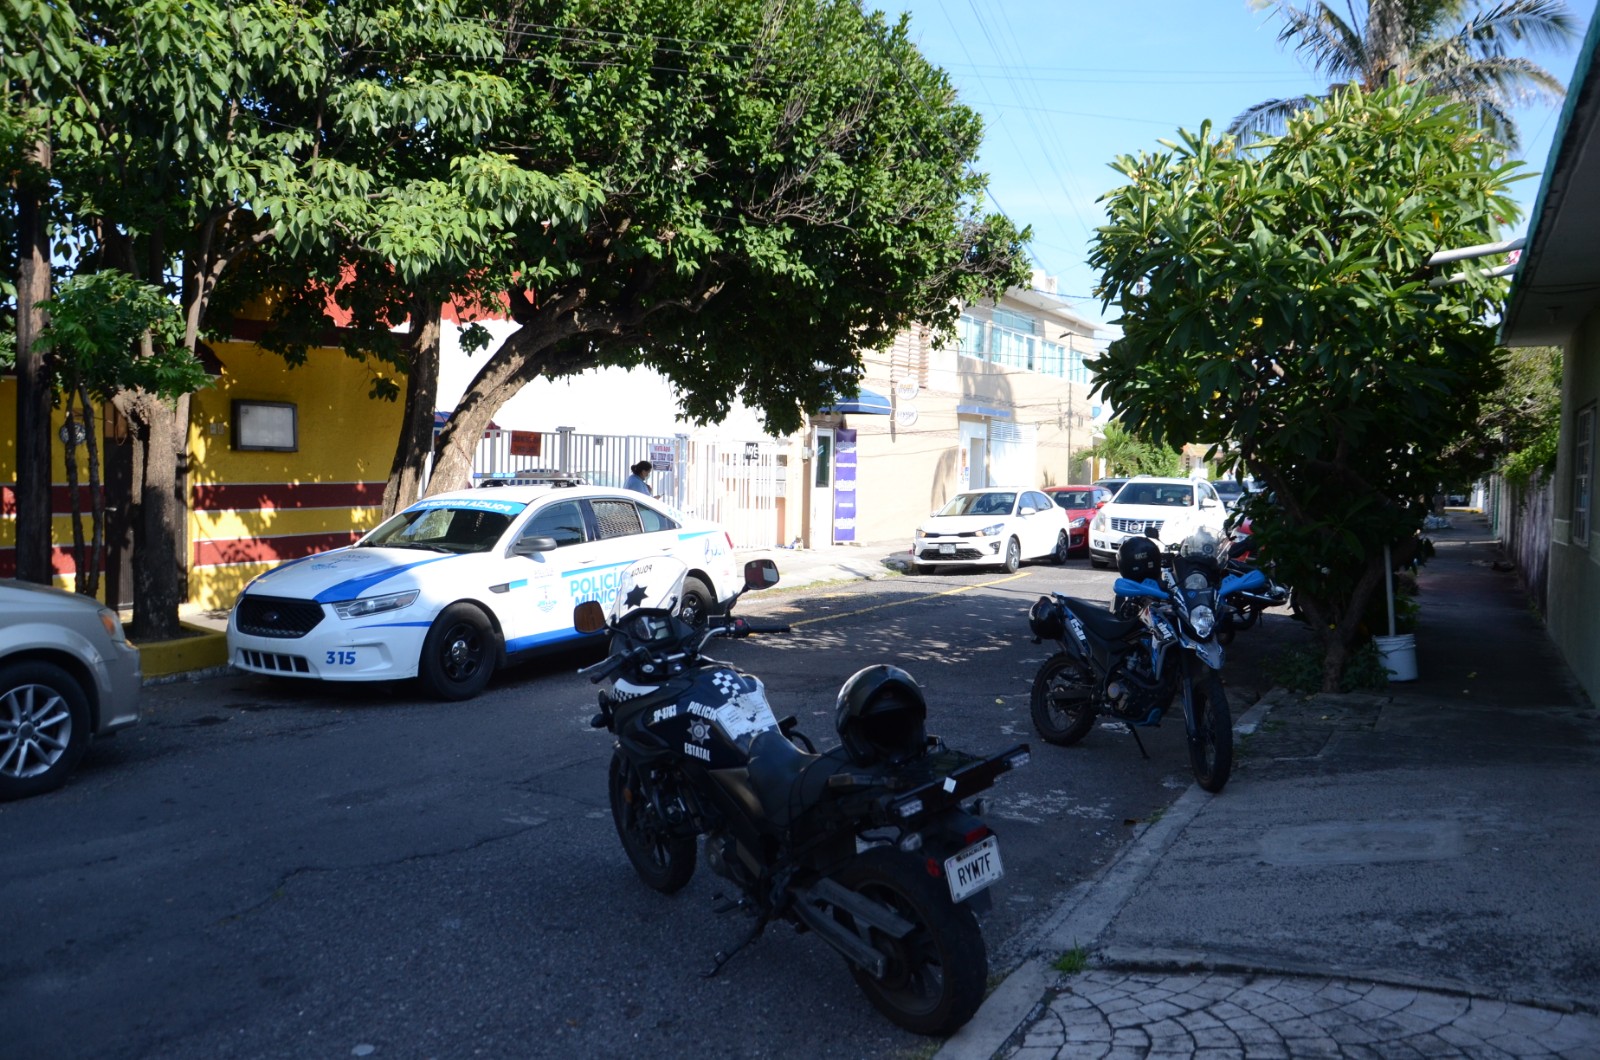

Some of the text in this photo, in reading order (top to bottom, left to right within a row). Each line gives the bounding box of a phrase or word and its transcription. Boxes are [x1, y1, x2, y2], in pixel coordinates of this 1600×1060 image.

[326, 650, 356, 665] 315
[684, 743, 711, 762] ESTATAL
[957, 852, 991, 887] RYM7F
